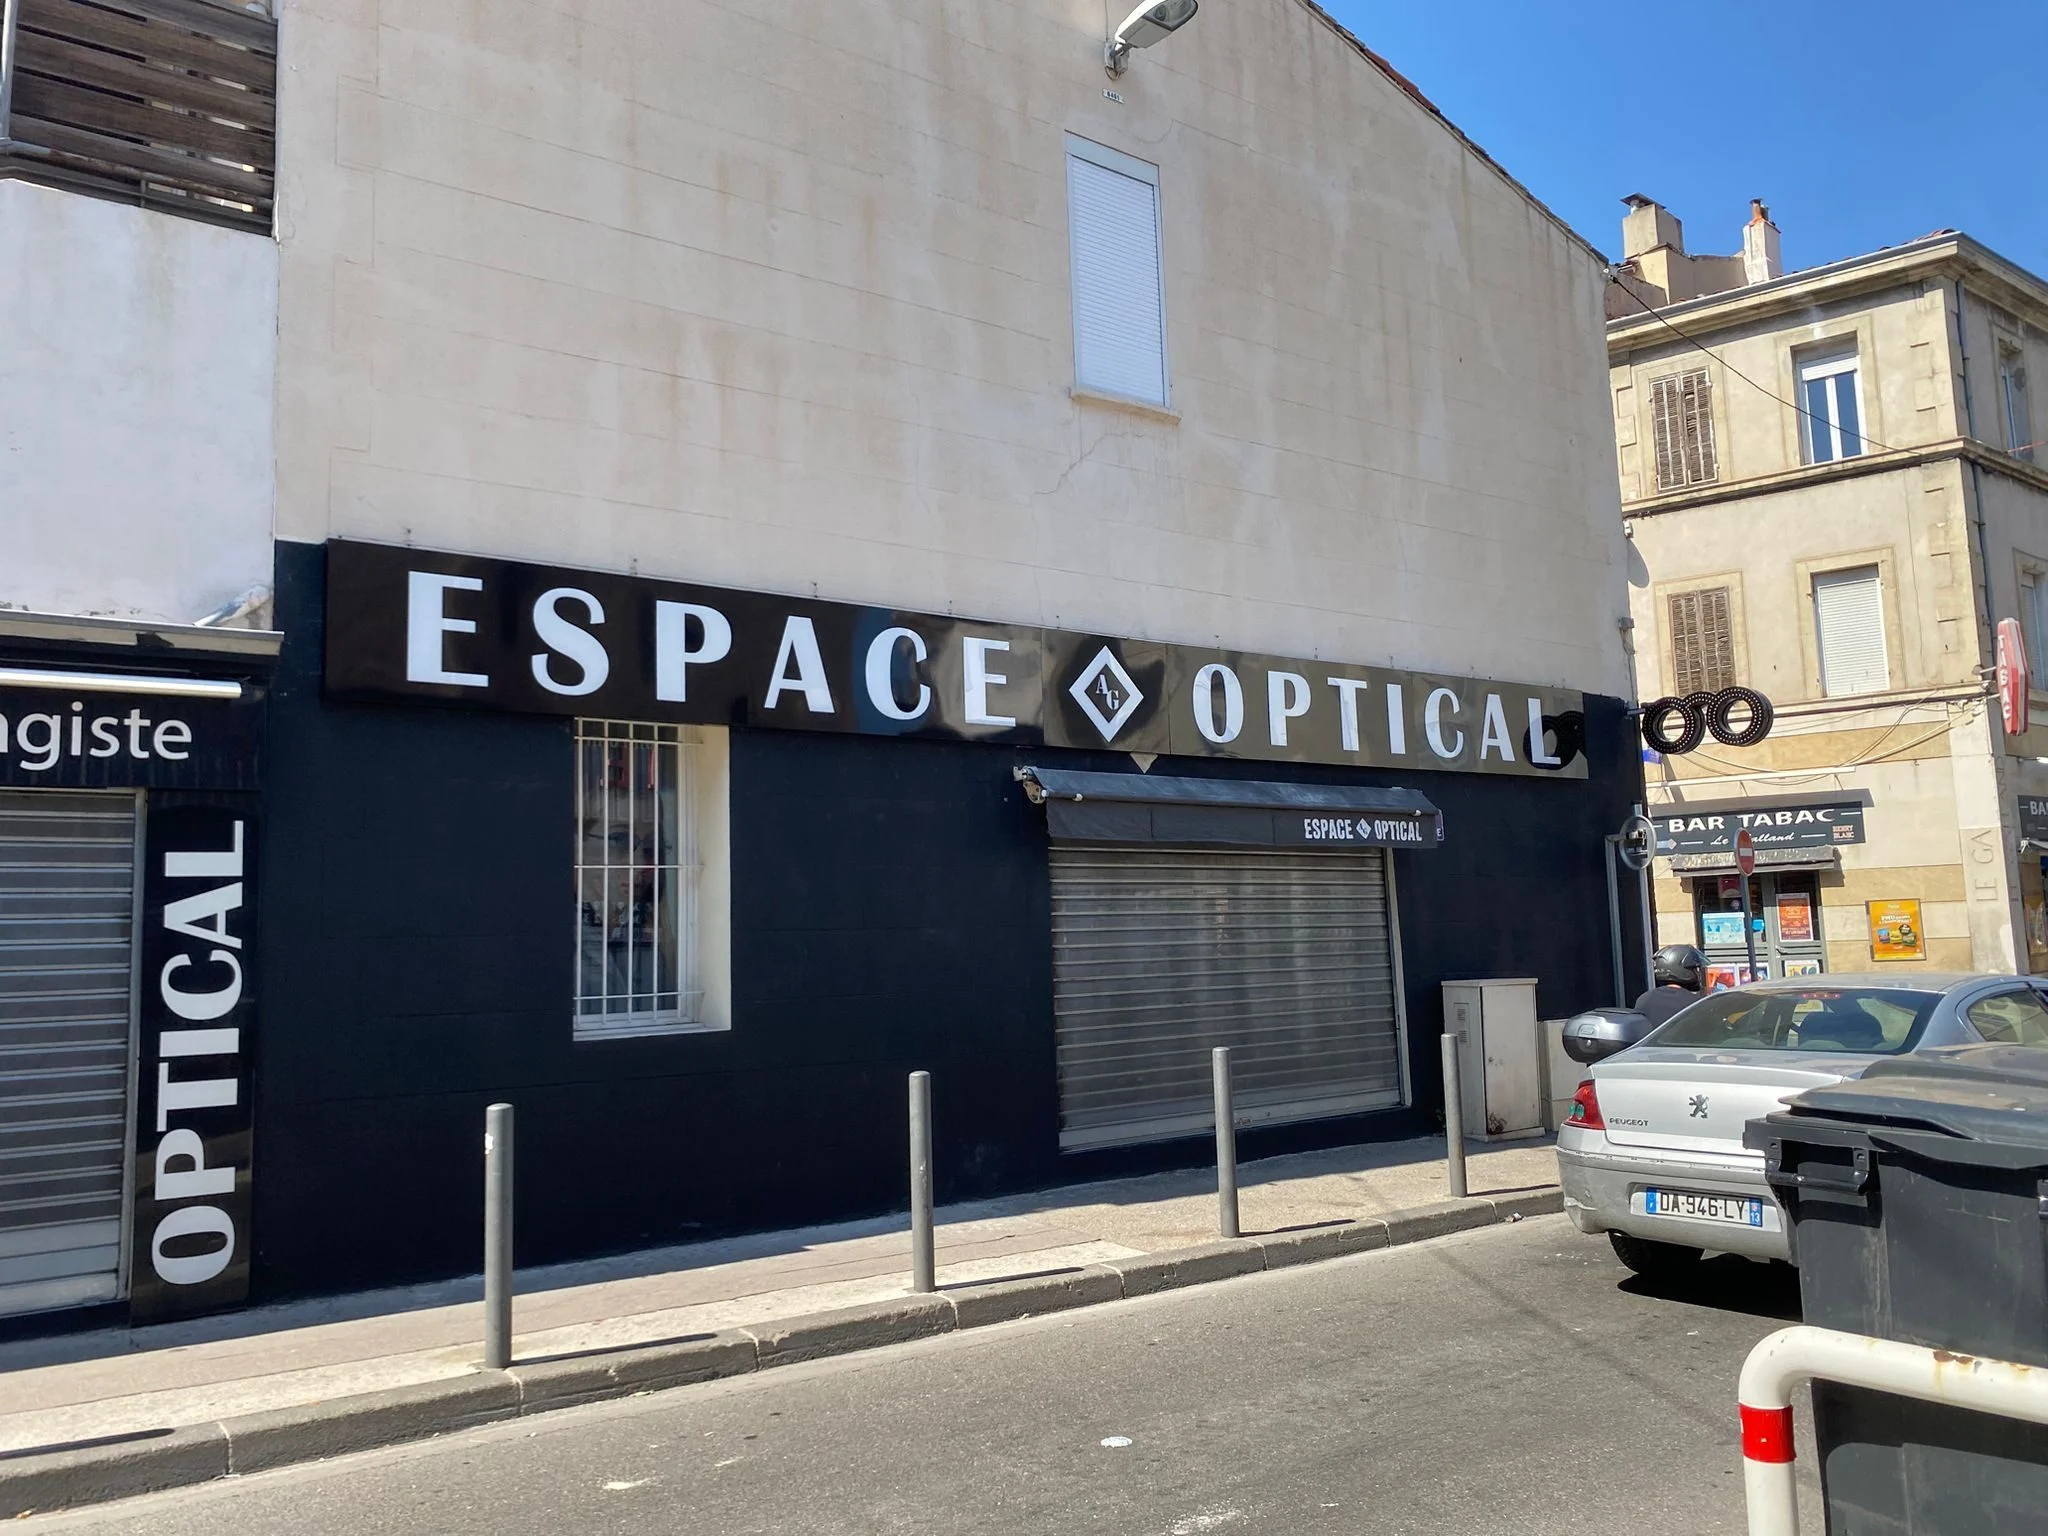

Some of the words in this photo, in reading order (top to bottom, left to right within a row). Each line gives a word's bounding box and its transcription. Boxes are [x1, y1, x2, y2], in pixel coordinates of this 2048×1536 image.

[406, 571, 1016, 727] ESPACE
[1192, 663, 1562, 765] OPTICAL
[0, 701, 193, 771] giste
[1304, 818, 1354, 839] ESPACE
[1374, 819, 1423, 841] OPTICAL
[1668, 817, 1726, 833] BAR
[1737, 809, 1835, 828] TABAC
[1710, 835, 1729, 846] Le
[1749, 832, 1795, 842] alland
[151, 820, 246, 1285] OPTICAL
[1609, 1117, 1649, 1127] PEUGEOT
[1750, 1213, 1761, 1223] 13
